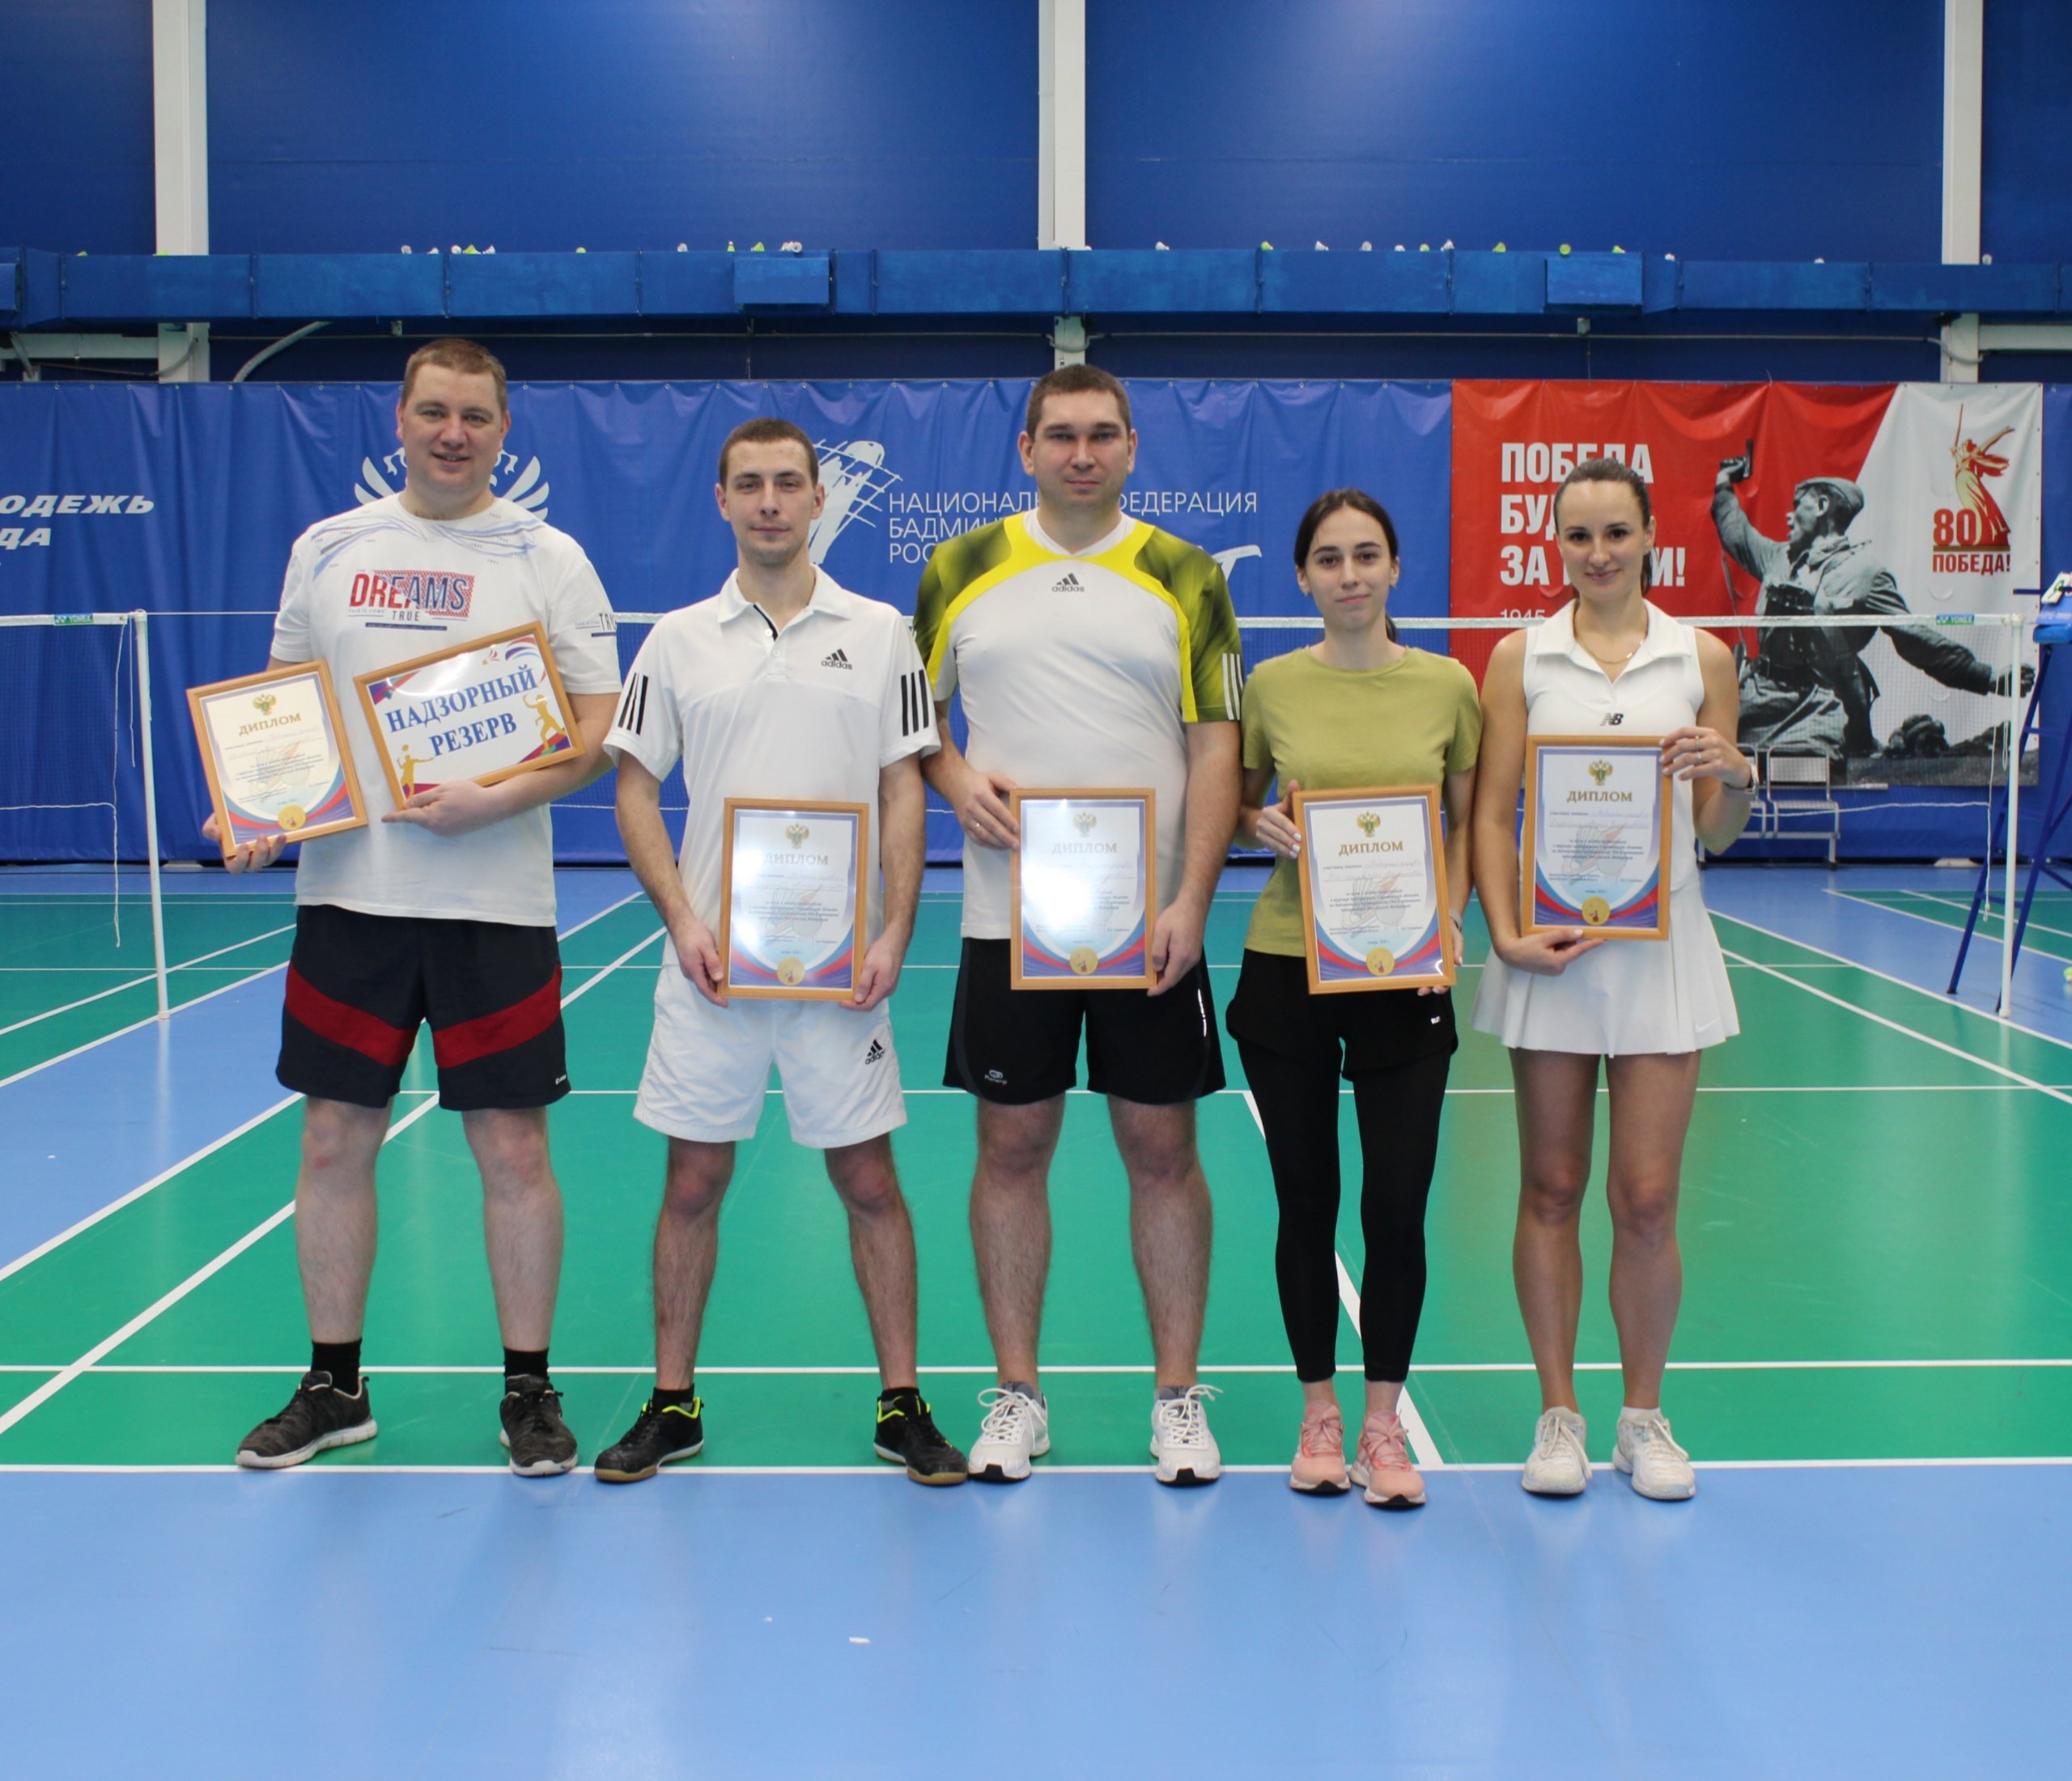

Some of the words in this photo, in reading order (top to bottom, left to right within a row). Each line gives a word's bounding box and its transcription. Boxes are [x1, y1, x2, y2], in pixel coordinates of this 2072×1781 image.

[1501, 494, 1556, 541] БУ
[1933, 509, 1976, 546] 80
[890, 518, 1003, 542] БАДМИ
[1500, 545, 1550, 586] ЗА
[1933, 554, 2010, 575] ПОБЕДА!
[350, 573, 467, 609] DREAMS
[67, 614, 91, 623] YONEX
[392, 610, 420, 621] TRUE
[1950, 615, 1973, 624] YONEX
[821, 660, 852, 670] adidas
[385, 664, 538, 733] НАДЗОРНЫЙ
[239, 713, 302, 736] ДИПЛОМ
[428, 713, 517, 757] РЕЗЕРВ
[1566, 791, 1633, 803] ДИПЛОМ
[1051, 842, 1118, 854] ДИПЛОМ
[1339, 841, 1403, 857] ДИПЛОМ
[764, 854, 829, 866] ДИПЛОМ
